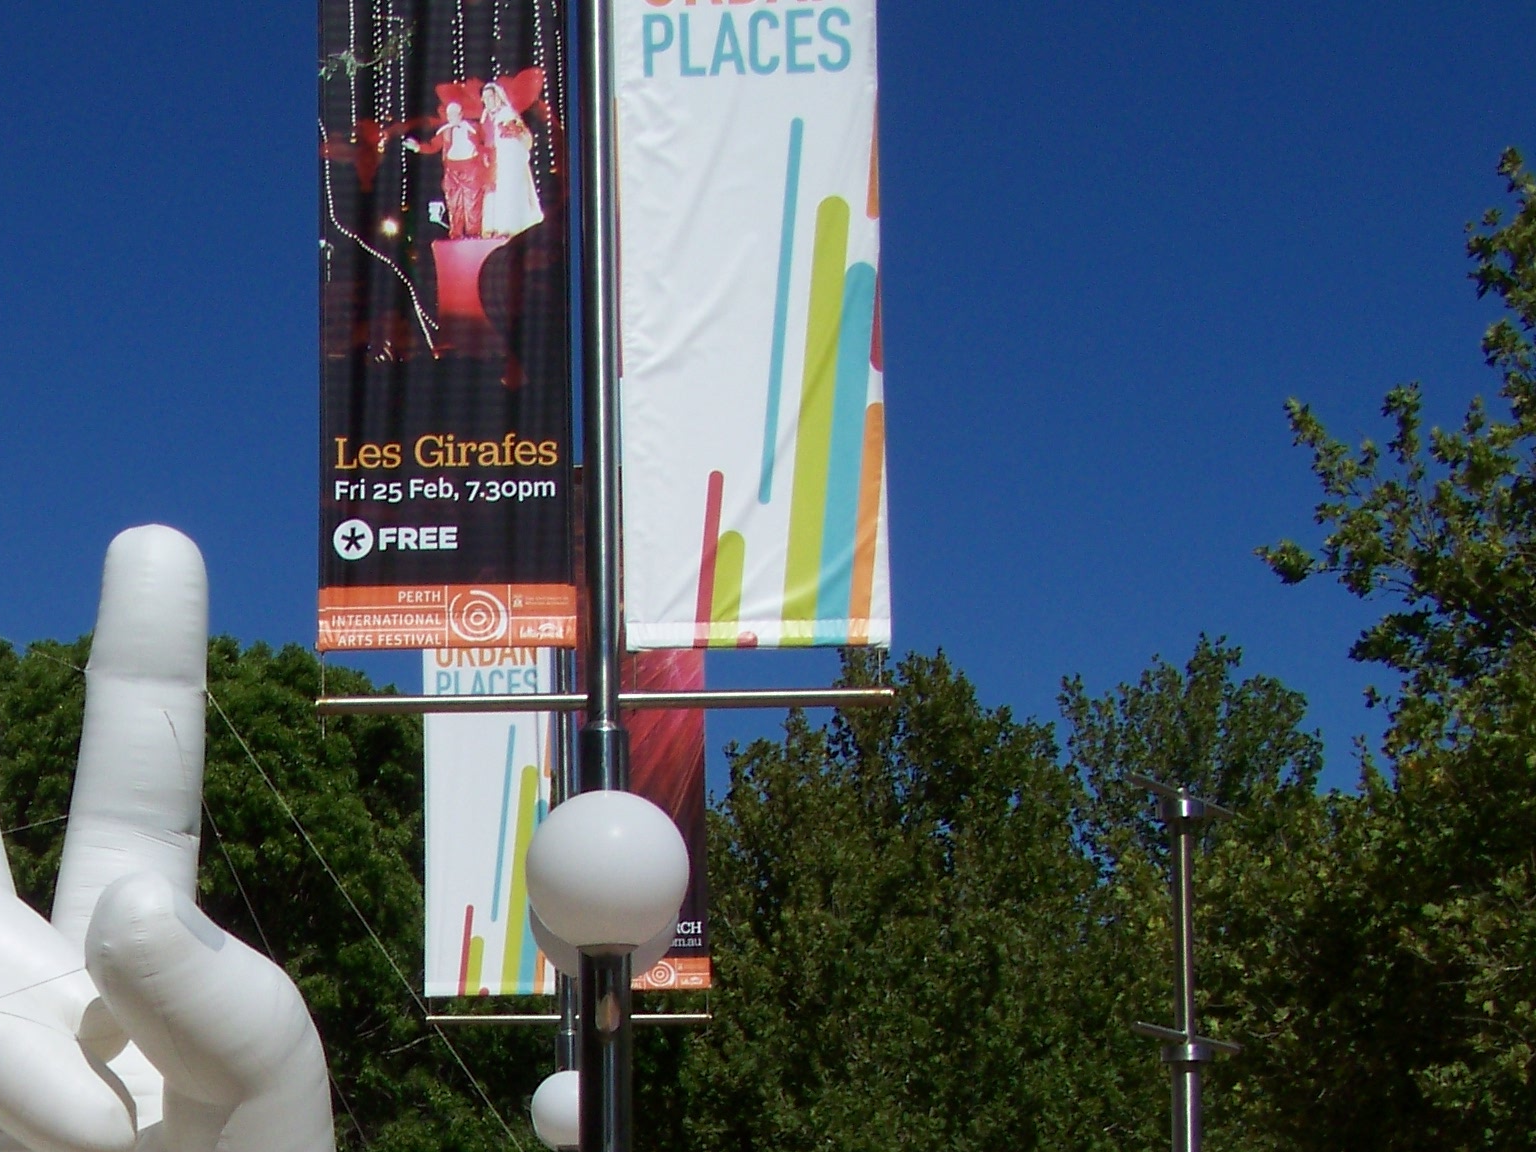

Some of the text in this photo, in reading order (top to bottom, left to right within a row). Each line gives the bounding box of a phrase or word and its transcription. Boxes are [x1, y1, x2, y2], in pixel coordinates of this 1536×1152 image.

[642, 7, 852, 78] PLACES
[334, 433, 559, 469] Les Girafes
[335, 477, 556, 503] Fri 25 Feb, 7.30pm
[379, 526, 458, 550] FREE
[398, 590, 441, 602] PERTH
[331, 613, 441, 627] INTERNATIONAL
[338, 630, 441, 646] ARTS FESTIVAL
